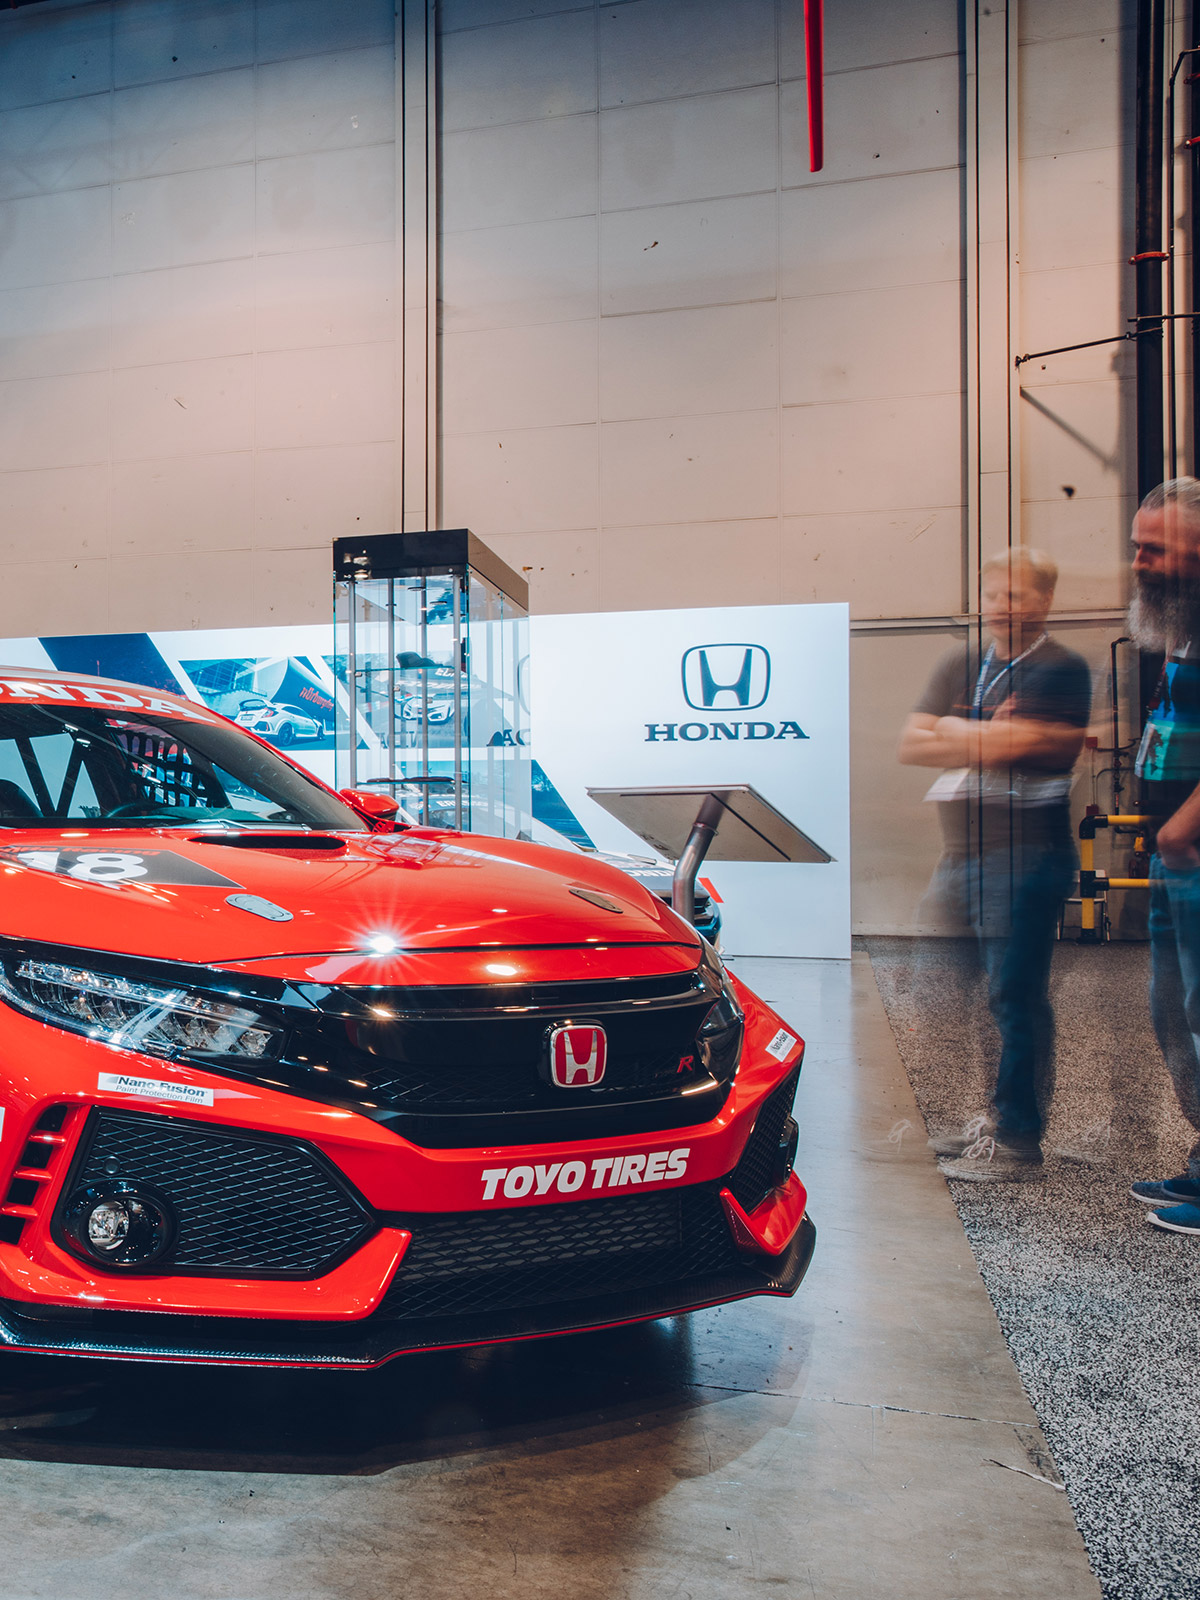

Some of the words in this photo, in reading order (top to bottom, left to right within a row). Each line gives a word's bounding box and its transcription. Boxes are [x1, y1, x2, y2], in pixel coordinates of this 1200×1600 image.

[644, 721, 811, 742] HONDA
[16, 850, 149, 882] 18
[676, 1055, 694, 1073] R
[115, 1085, 138, 1094] Paint
[140, 1088, 183, 1101] Protection
[184, 1096, 204, 1104] Film
[481, 1160, 587, 1200] TOYO
[590, 1147, 690, 1189] TIRES
